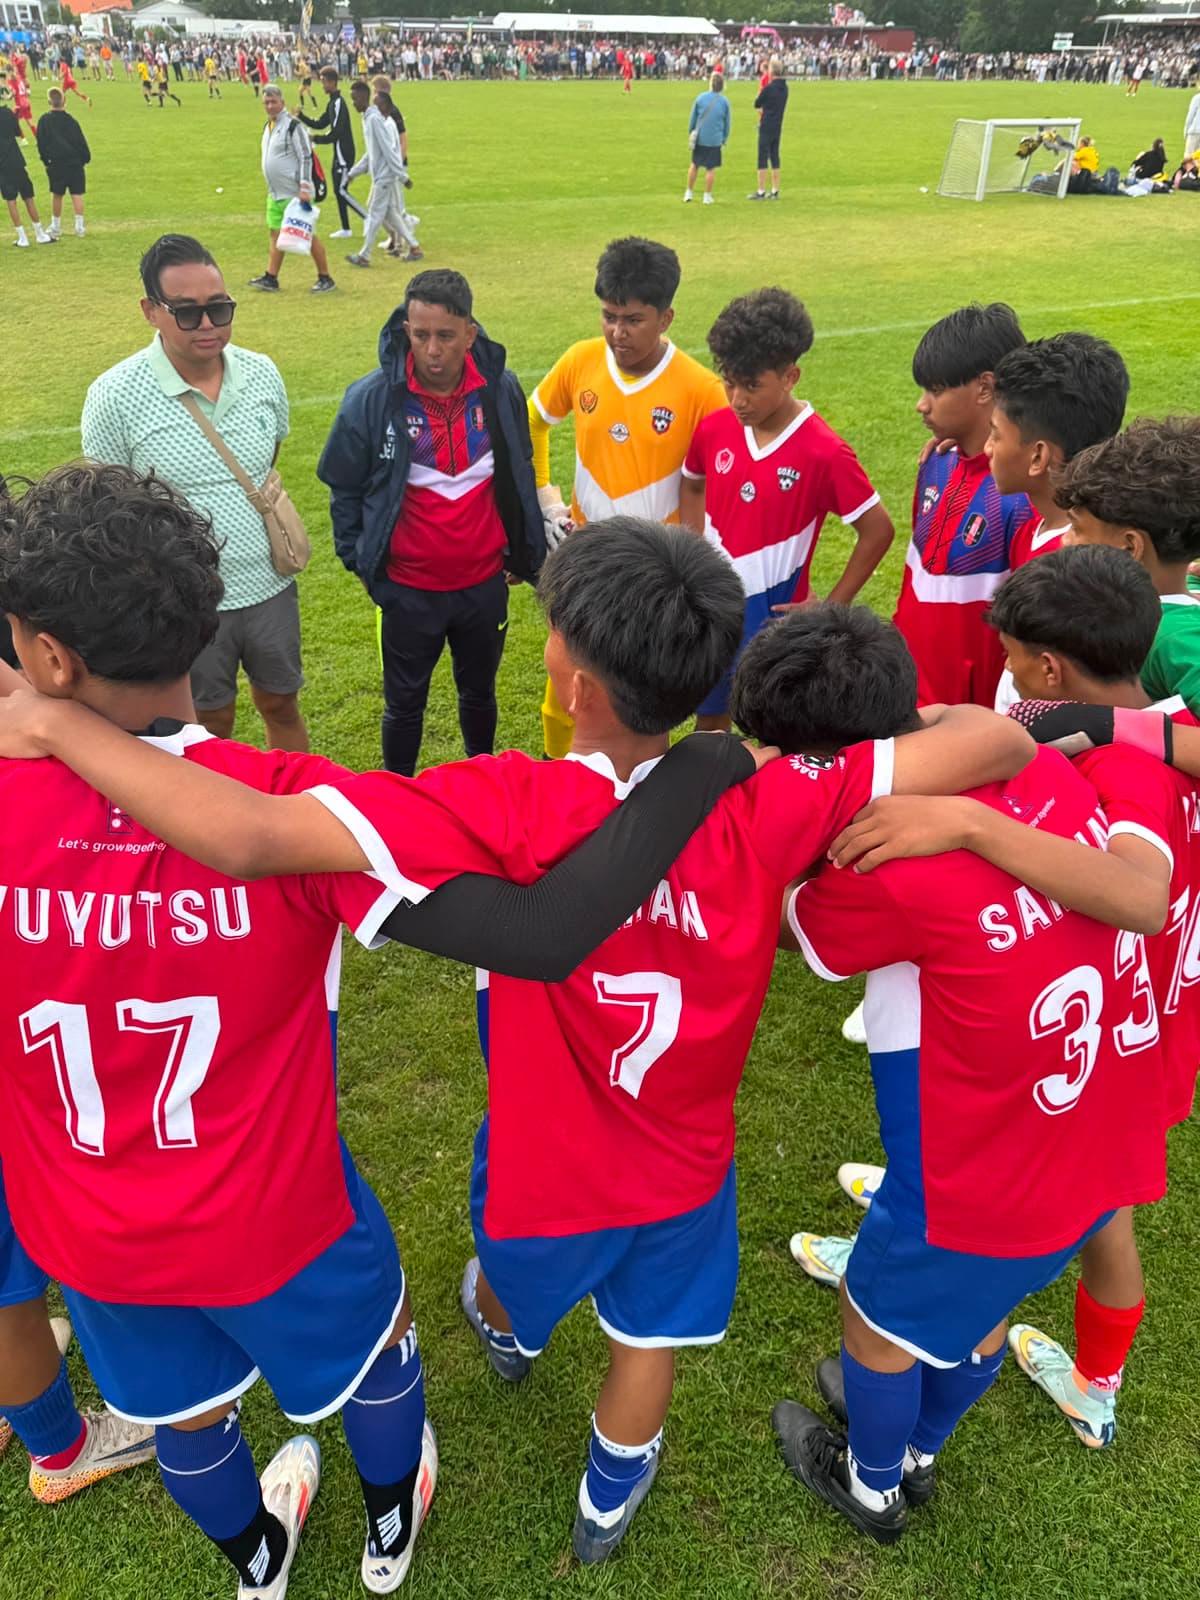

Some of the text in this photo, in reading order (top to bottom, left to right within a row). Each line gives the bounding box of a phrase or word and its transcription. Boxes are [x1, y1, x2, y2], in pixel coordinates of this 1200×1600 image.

[58, 837, 90, 850] Let's
[92, 842, 125, 853] grow
[18, 995, 221, 1157] 17
[592, 971, 682, 1100] 7
